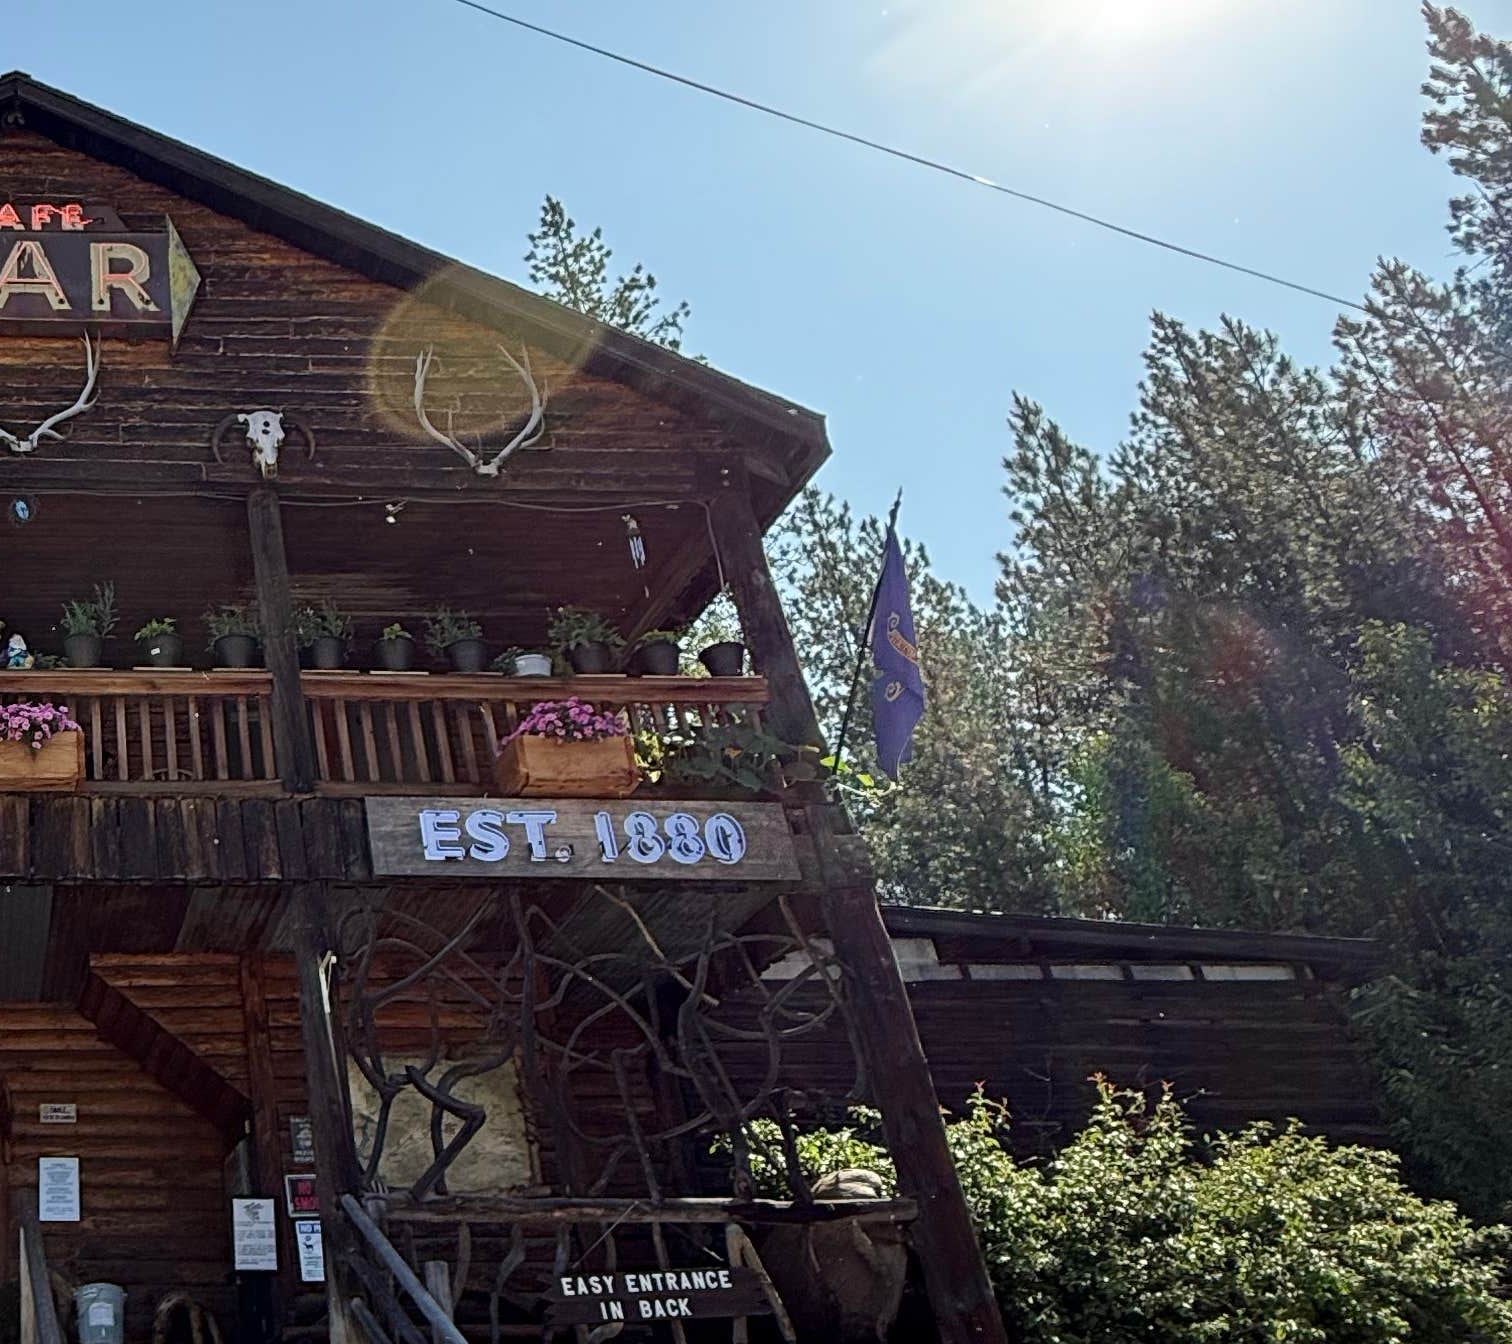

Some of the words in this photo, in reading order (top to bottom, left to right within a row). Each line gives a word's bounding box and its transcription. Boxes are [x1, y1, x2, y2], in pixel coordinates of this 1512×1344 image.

[419, 809, 575, 863] EST.
[594, 810, 747, 865] 1880
[560, 1275, 615, 1296] EASY
[625, 1270, 733, 1293] ENTRANCE
[600, 1301, 625, 1320] IN
[639, 1298, 693, 1319] BACK
